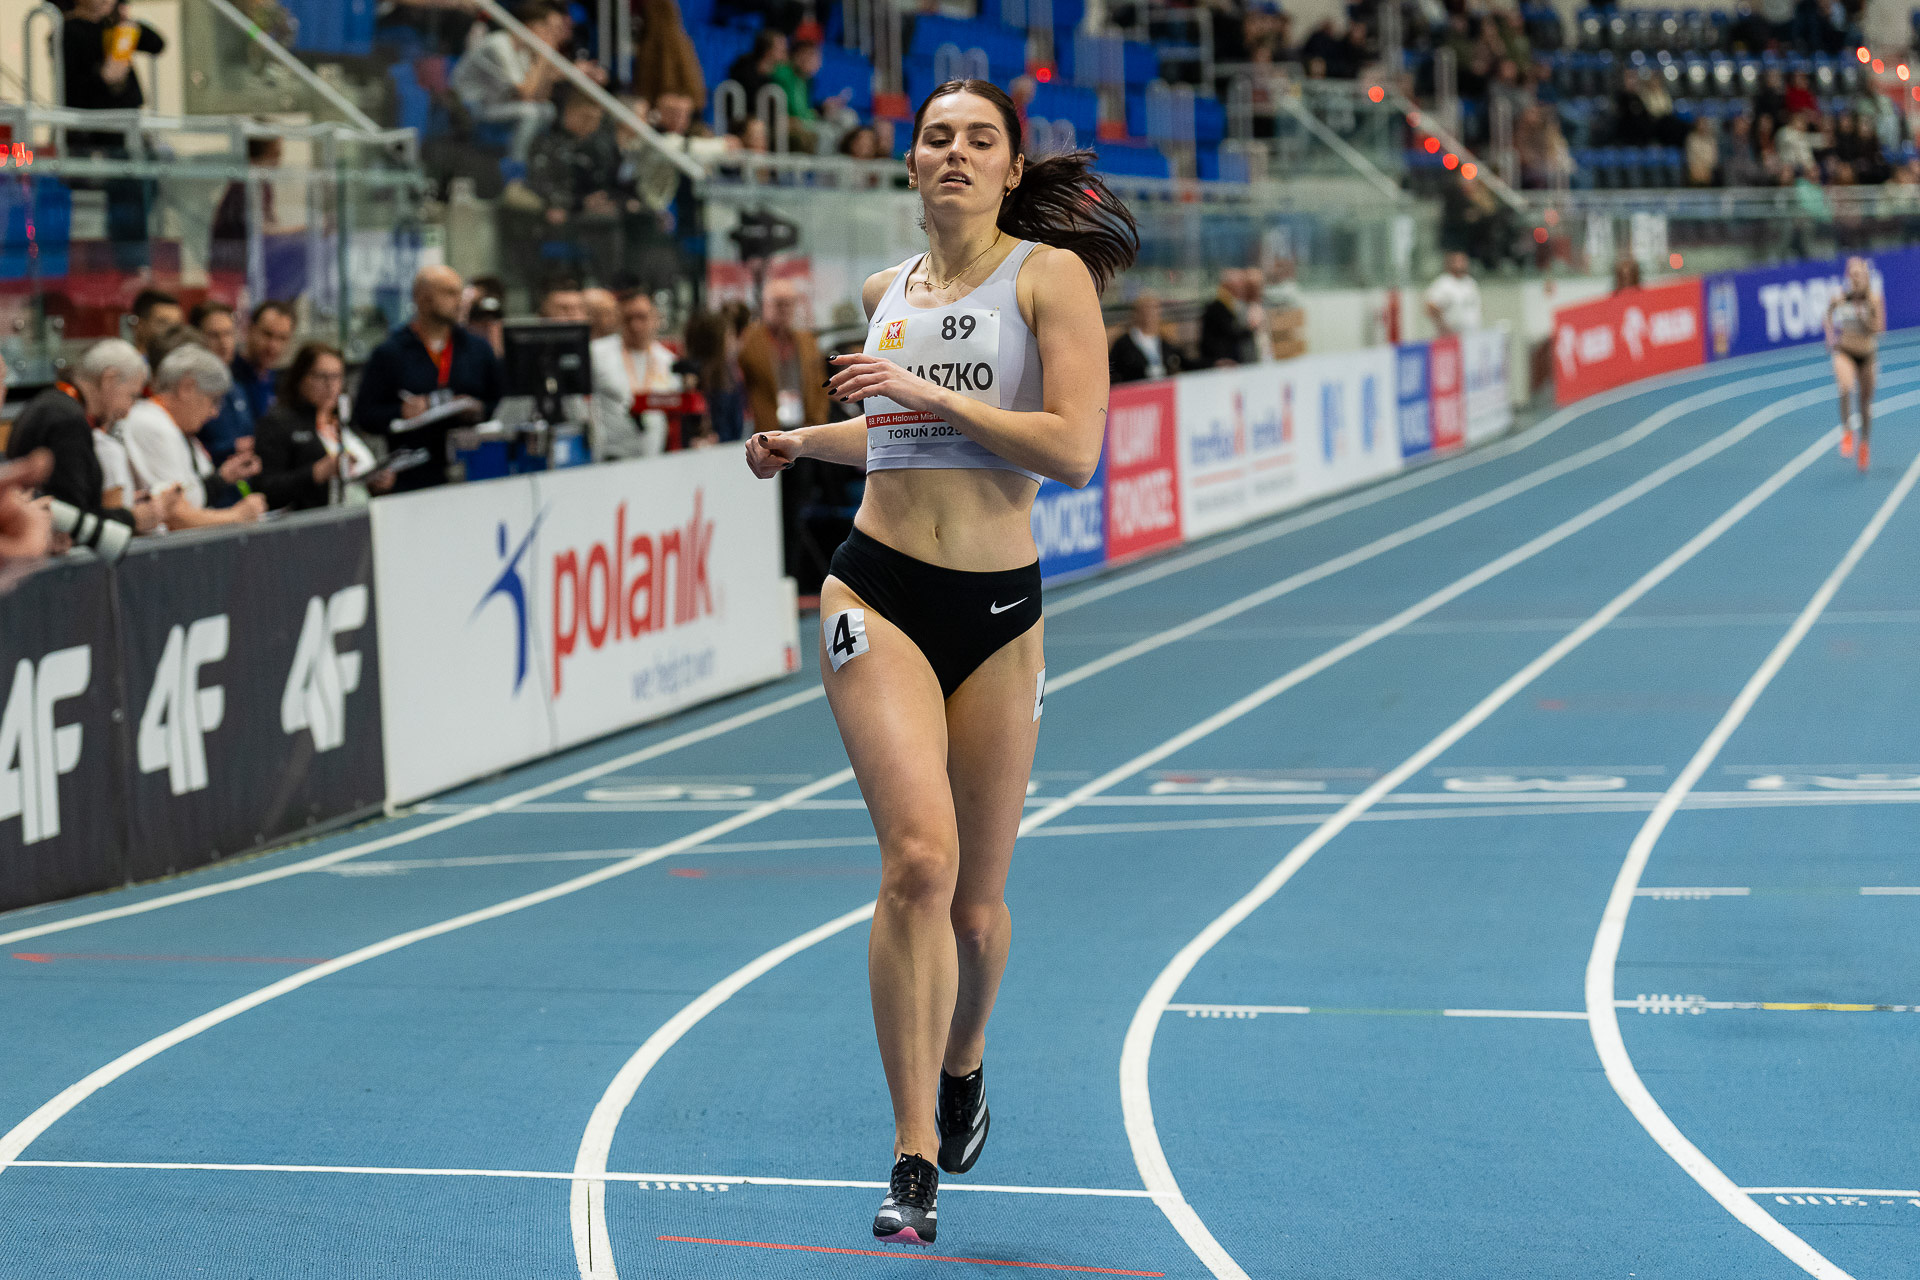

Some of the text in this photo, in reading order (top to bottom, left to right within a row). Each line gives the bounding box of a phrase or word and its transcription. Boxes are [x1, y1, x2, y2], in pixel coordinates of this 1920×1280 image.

[941, 314, 977, 341] 89
[906, 362, 994, 392] ASZKO
[888, 425, 928, 439] TORUŃ
[892, 412, 919, 423] Halowe
[552, 487, 715, 700] polanik
[832, 612, 858, 657] 4
[281, 583, 369, 753] 4F
[137, 613, 230, 796] 4F
[0, 643, 93, 846] 4F
